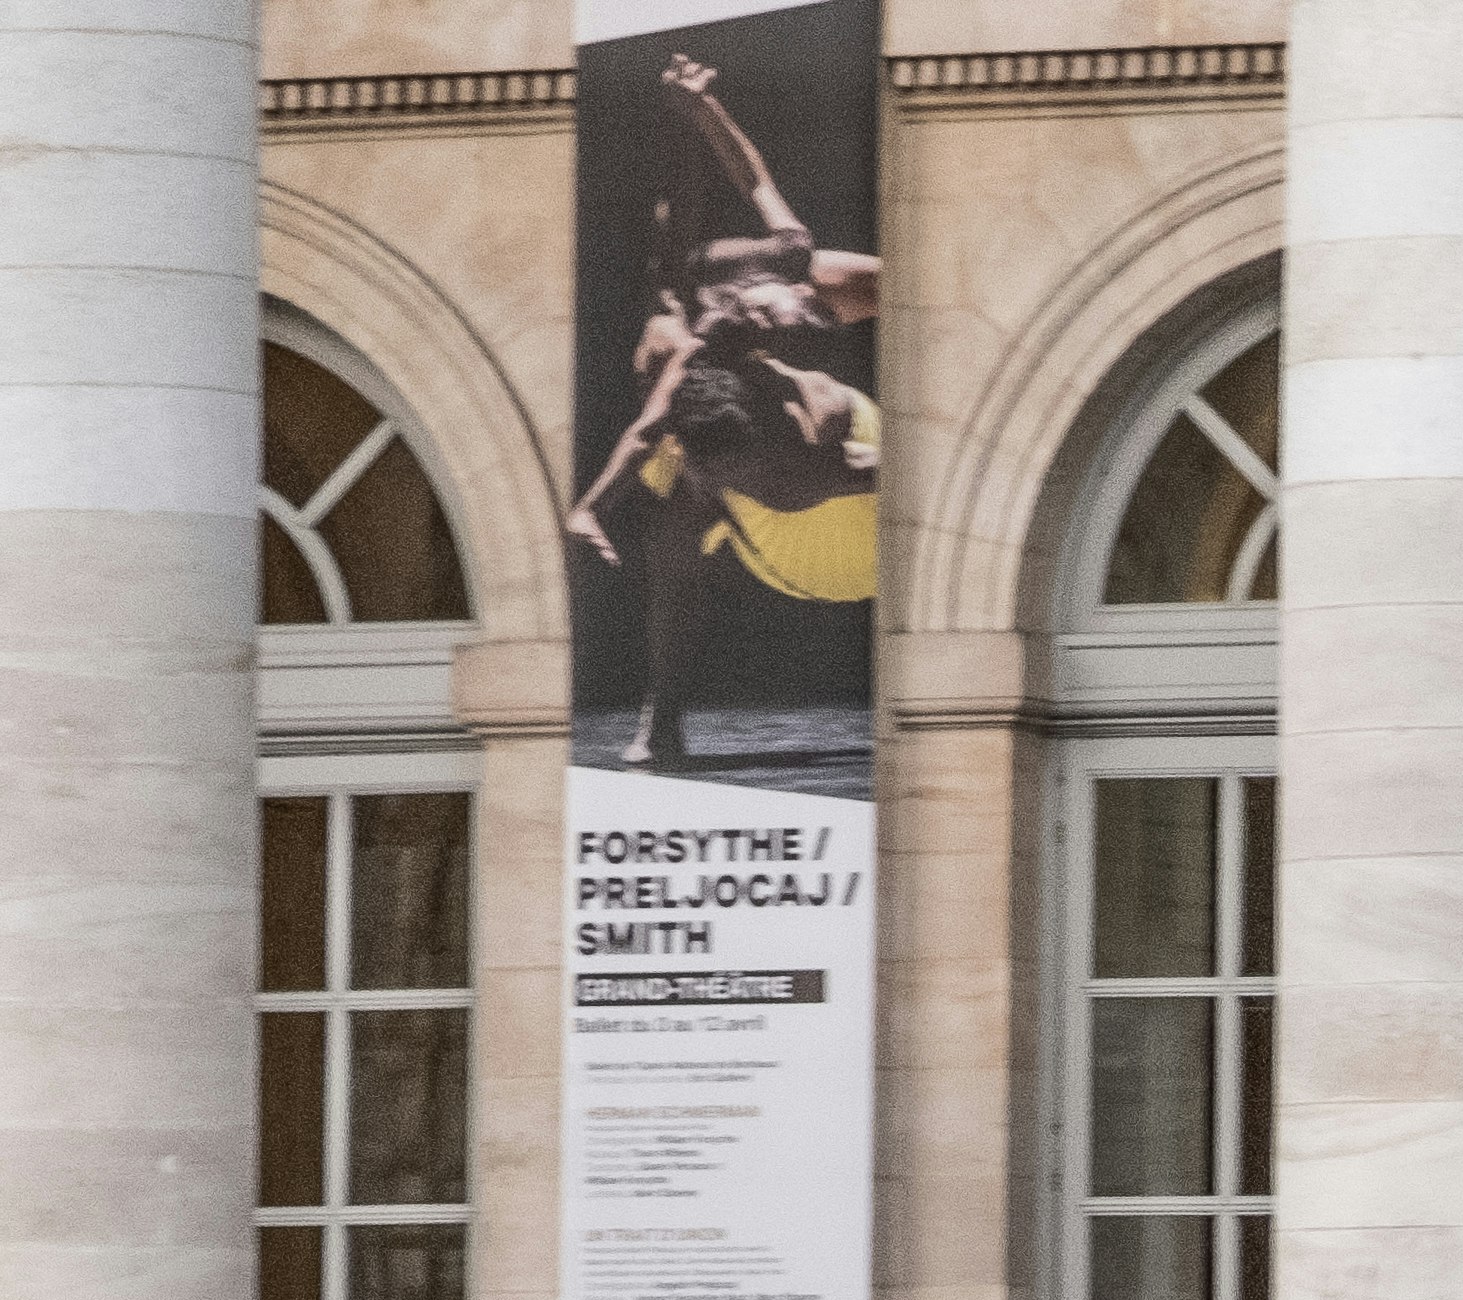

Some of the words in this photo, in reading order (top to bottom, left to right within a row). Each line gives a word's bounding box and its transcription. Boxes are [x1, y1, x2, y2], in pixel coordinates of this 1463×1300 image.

[576, 827, 801, 863] FORSYTHE
[576, 871, 830, 909] PRELJOCAJ
[576, 920, 712, 955] SMITH
